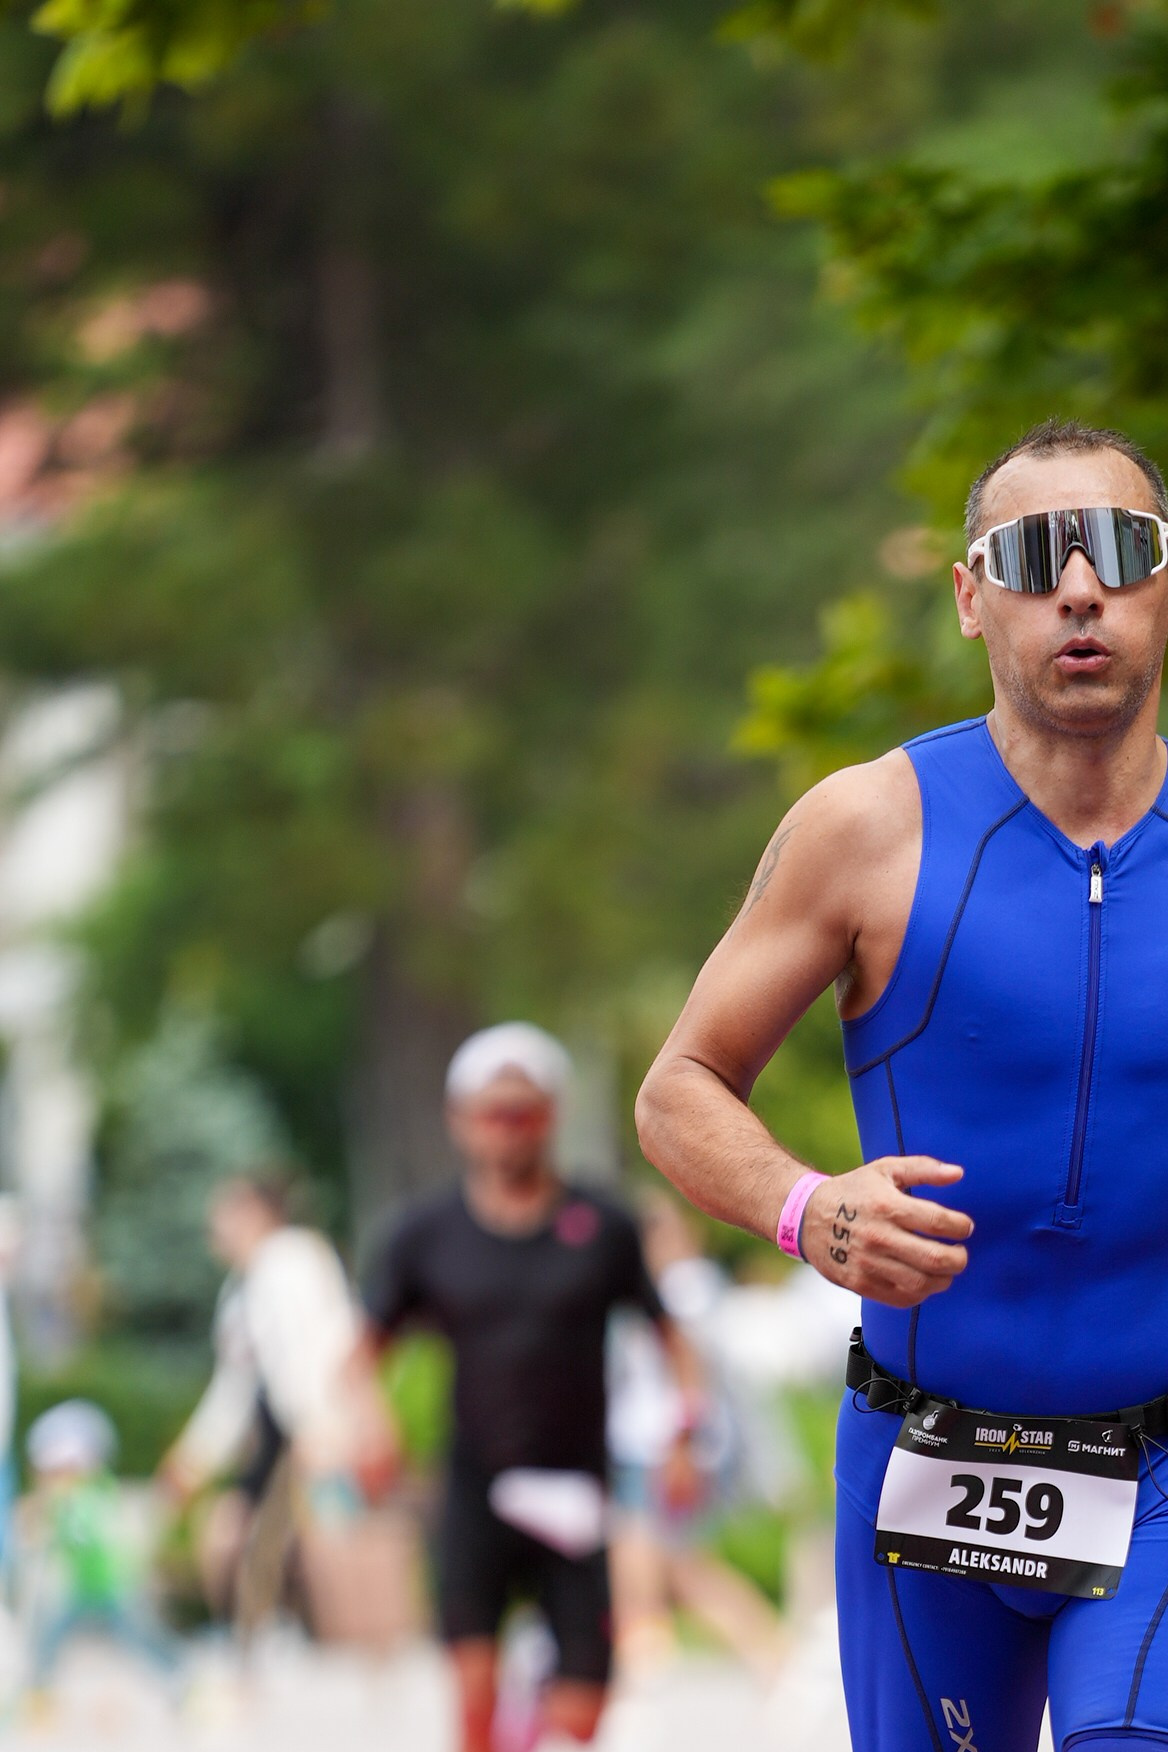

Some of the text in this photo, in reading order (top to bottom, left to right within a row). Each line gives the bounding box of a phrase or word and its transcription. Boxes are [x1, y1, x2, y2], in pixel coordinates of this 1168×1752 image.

[829, 1202, 857, 1265] 259
[975, 1427, 1054, 1445] IRON STAR
[1081, 1443, 1126, 1457] МАГНИТ
[945, 1474, 1065, 1542] 259
[948, 1547, 1049, 1579] ALEKSANDR
[1092, 1586, 1105, 1596] 113
